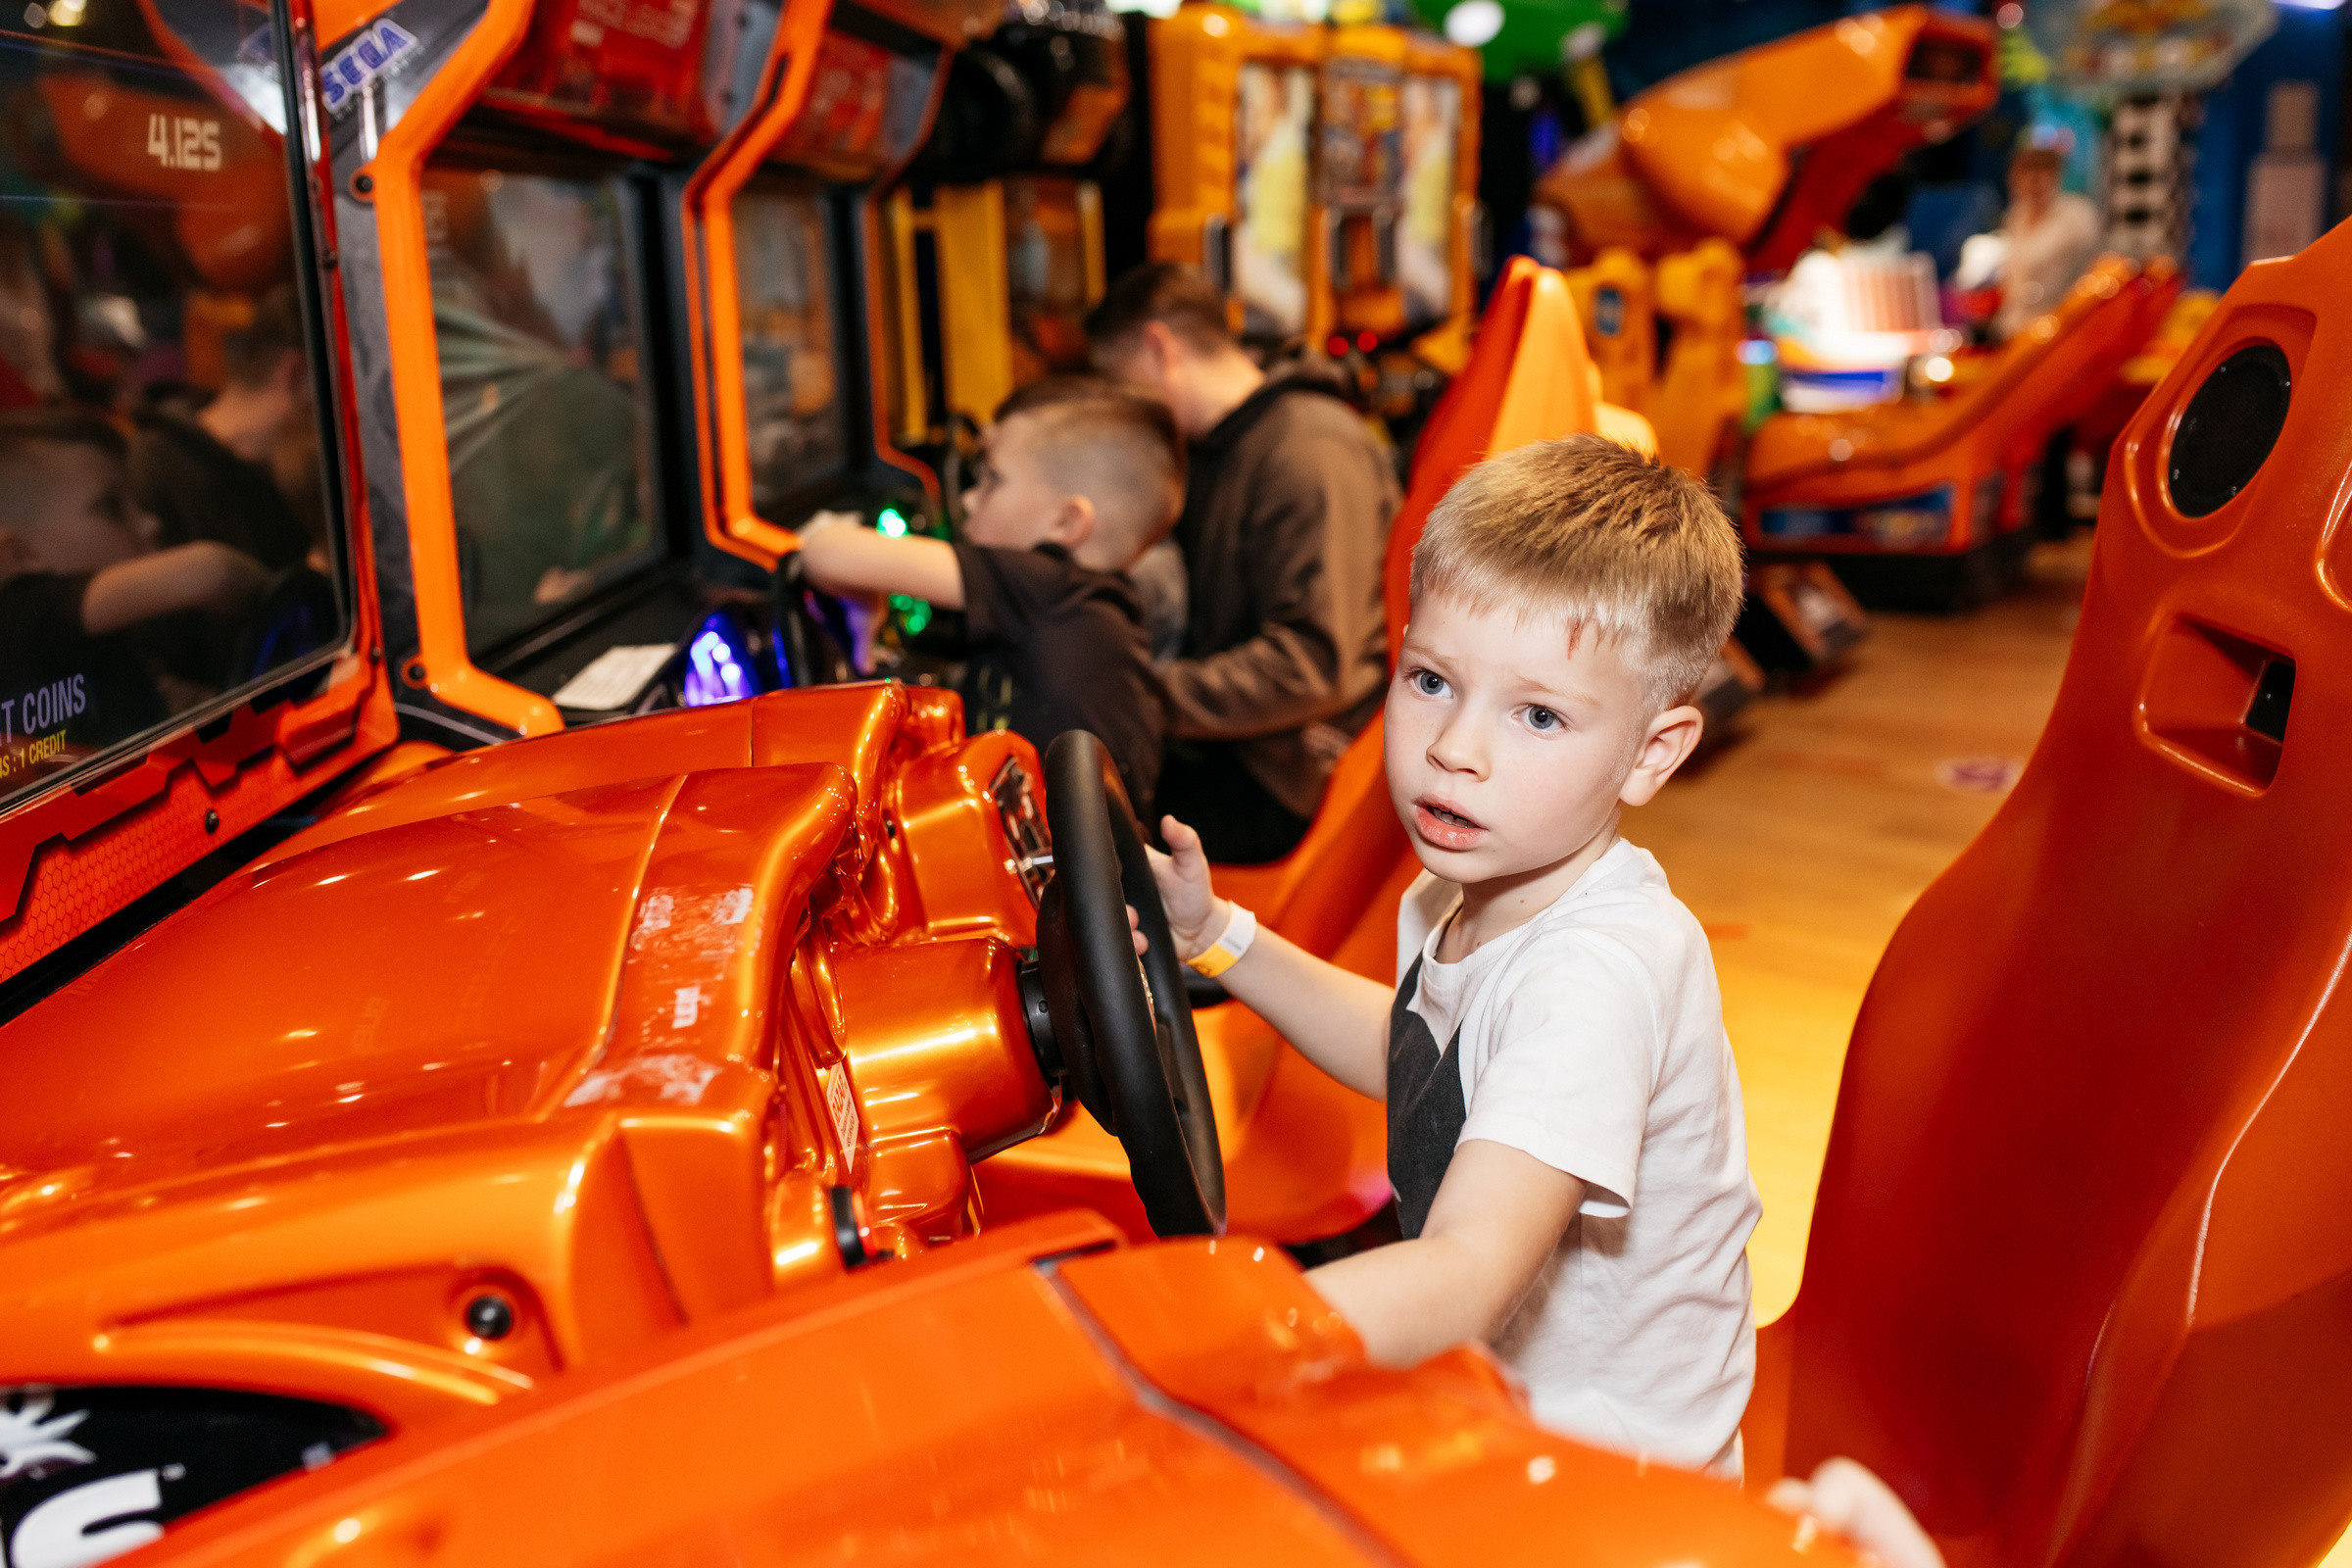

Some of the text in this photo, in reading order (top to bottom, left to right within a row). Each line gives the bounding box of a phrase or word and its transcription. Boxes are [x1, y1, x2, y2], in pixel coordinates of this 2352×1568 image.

[319, 22, 414, 108] SEGA
[23, 673, 85, 735] COINS
[20, 748, 25, 768] 1
[28, 729, 67, 764] CREDIT
